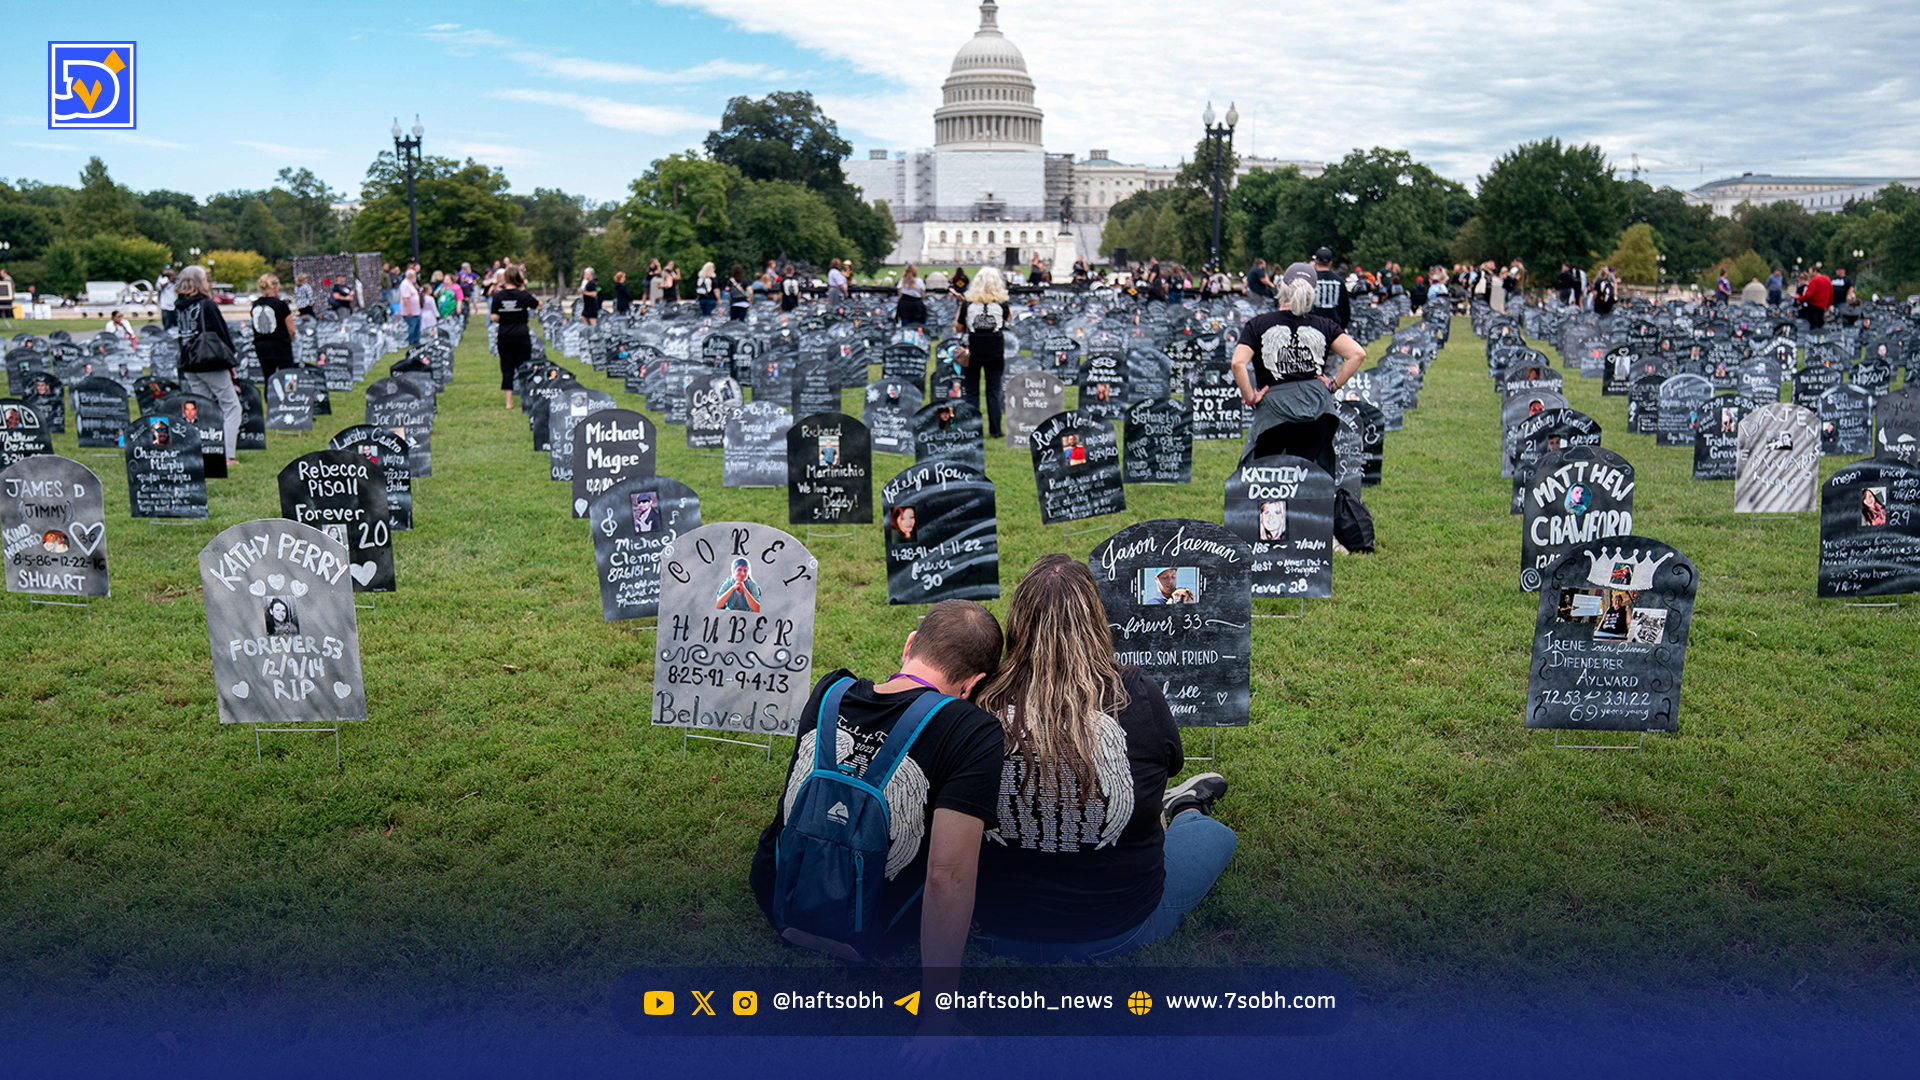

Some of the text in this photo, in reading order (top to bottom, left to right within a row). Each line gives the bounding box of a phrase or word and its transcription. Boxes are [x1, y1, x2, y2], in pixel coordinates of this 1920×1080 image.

[287, 392, 310, 405] Cody
[1193, 387, 1243, 398] MONICA
[585, 420, 645, 445] Michael
[801, 422, 842, 438] Richard
[1525, 439, 1538, 452] 21
[150, 458, 185, 474] Murphy
[586, 446, 640, 475] Magee
[298, 461, 369, 481] Rebecca
[5, 478, 86, 498] JAMES D
[308, 478, 358, 498] Pisall
[796, 481, 844, 498] We love you
[883, 467, 930, 504] Katelyn
[1247, 483, 1299, 500] DOODY
[1532, 461, 1635, 509] MATTHEW
[295, 503, 365, 522] Forever
[1889, 510, 1911, 527] 29
[2, 523, 31, 545] KIND
[358, 519, 389, 550] 20
[1530, 510, 1633, 547] CRAWFORD
[3, 532, 43, 560] HEARTED
[614, 528, 677, 552] Michael
[210, 532, 349, 592] KATHY PERRY
[609, 550, 663, 567] Cleme
[667, 527, 812, 587] COREY
[1101, 535, 1158, 582] Jason
[1250, 559, 1273, 573] dest
[18, 569, 87, 591] SHUART
[911, 559, 955, 581] forever
[921, 572, 944, 591] 30
[1250, 577, 1309, 595] rever 28
[672, 614, 794, 648] HUBER
[1122, 613, 1203, 640] forever 33
[230, 636, 345, 661] FOREVER 53
[1541, 630, 1587, 653] IRENE
[261, 653, 326, 679] 12/9/14
[1156, 650, 1180, 667] SON,
[1181, 650, 1219, 666] FRIEND
[1549, 650, 1625, 670] DIFENDERER
[1575, 667, 1639, 688] AYLWARD
[272, 678, 316, 701] RIP
[1174, 684, 1202, 699] see
[652, 690, 757, 732] Beloved
[1168, 702, 1200, 718] gain.
[1569, 704, 1598, 722] 69
[854, 742, 875, 754] 2022
